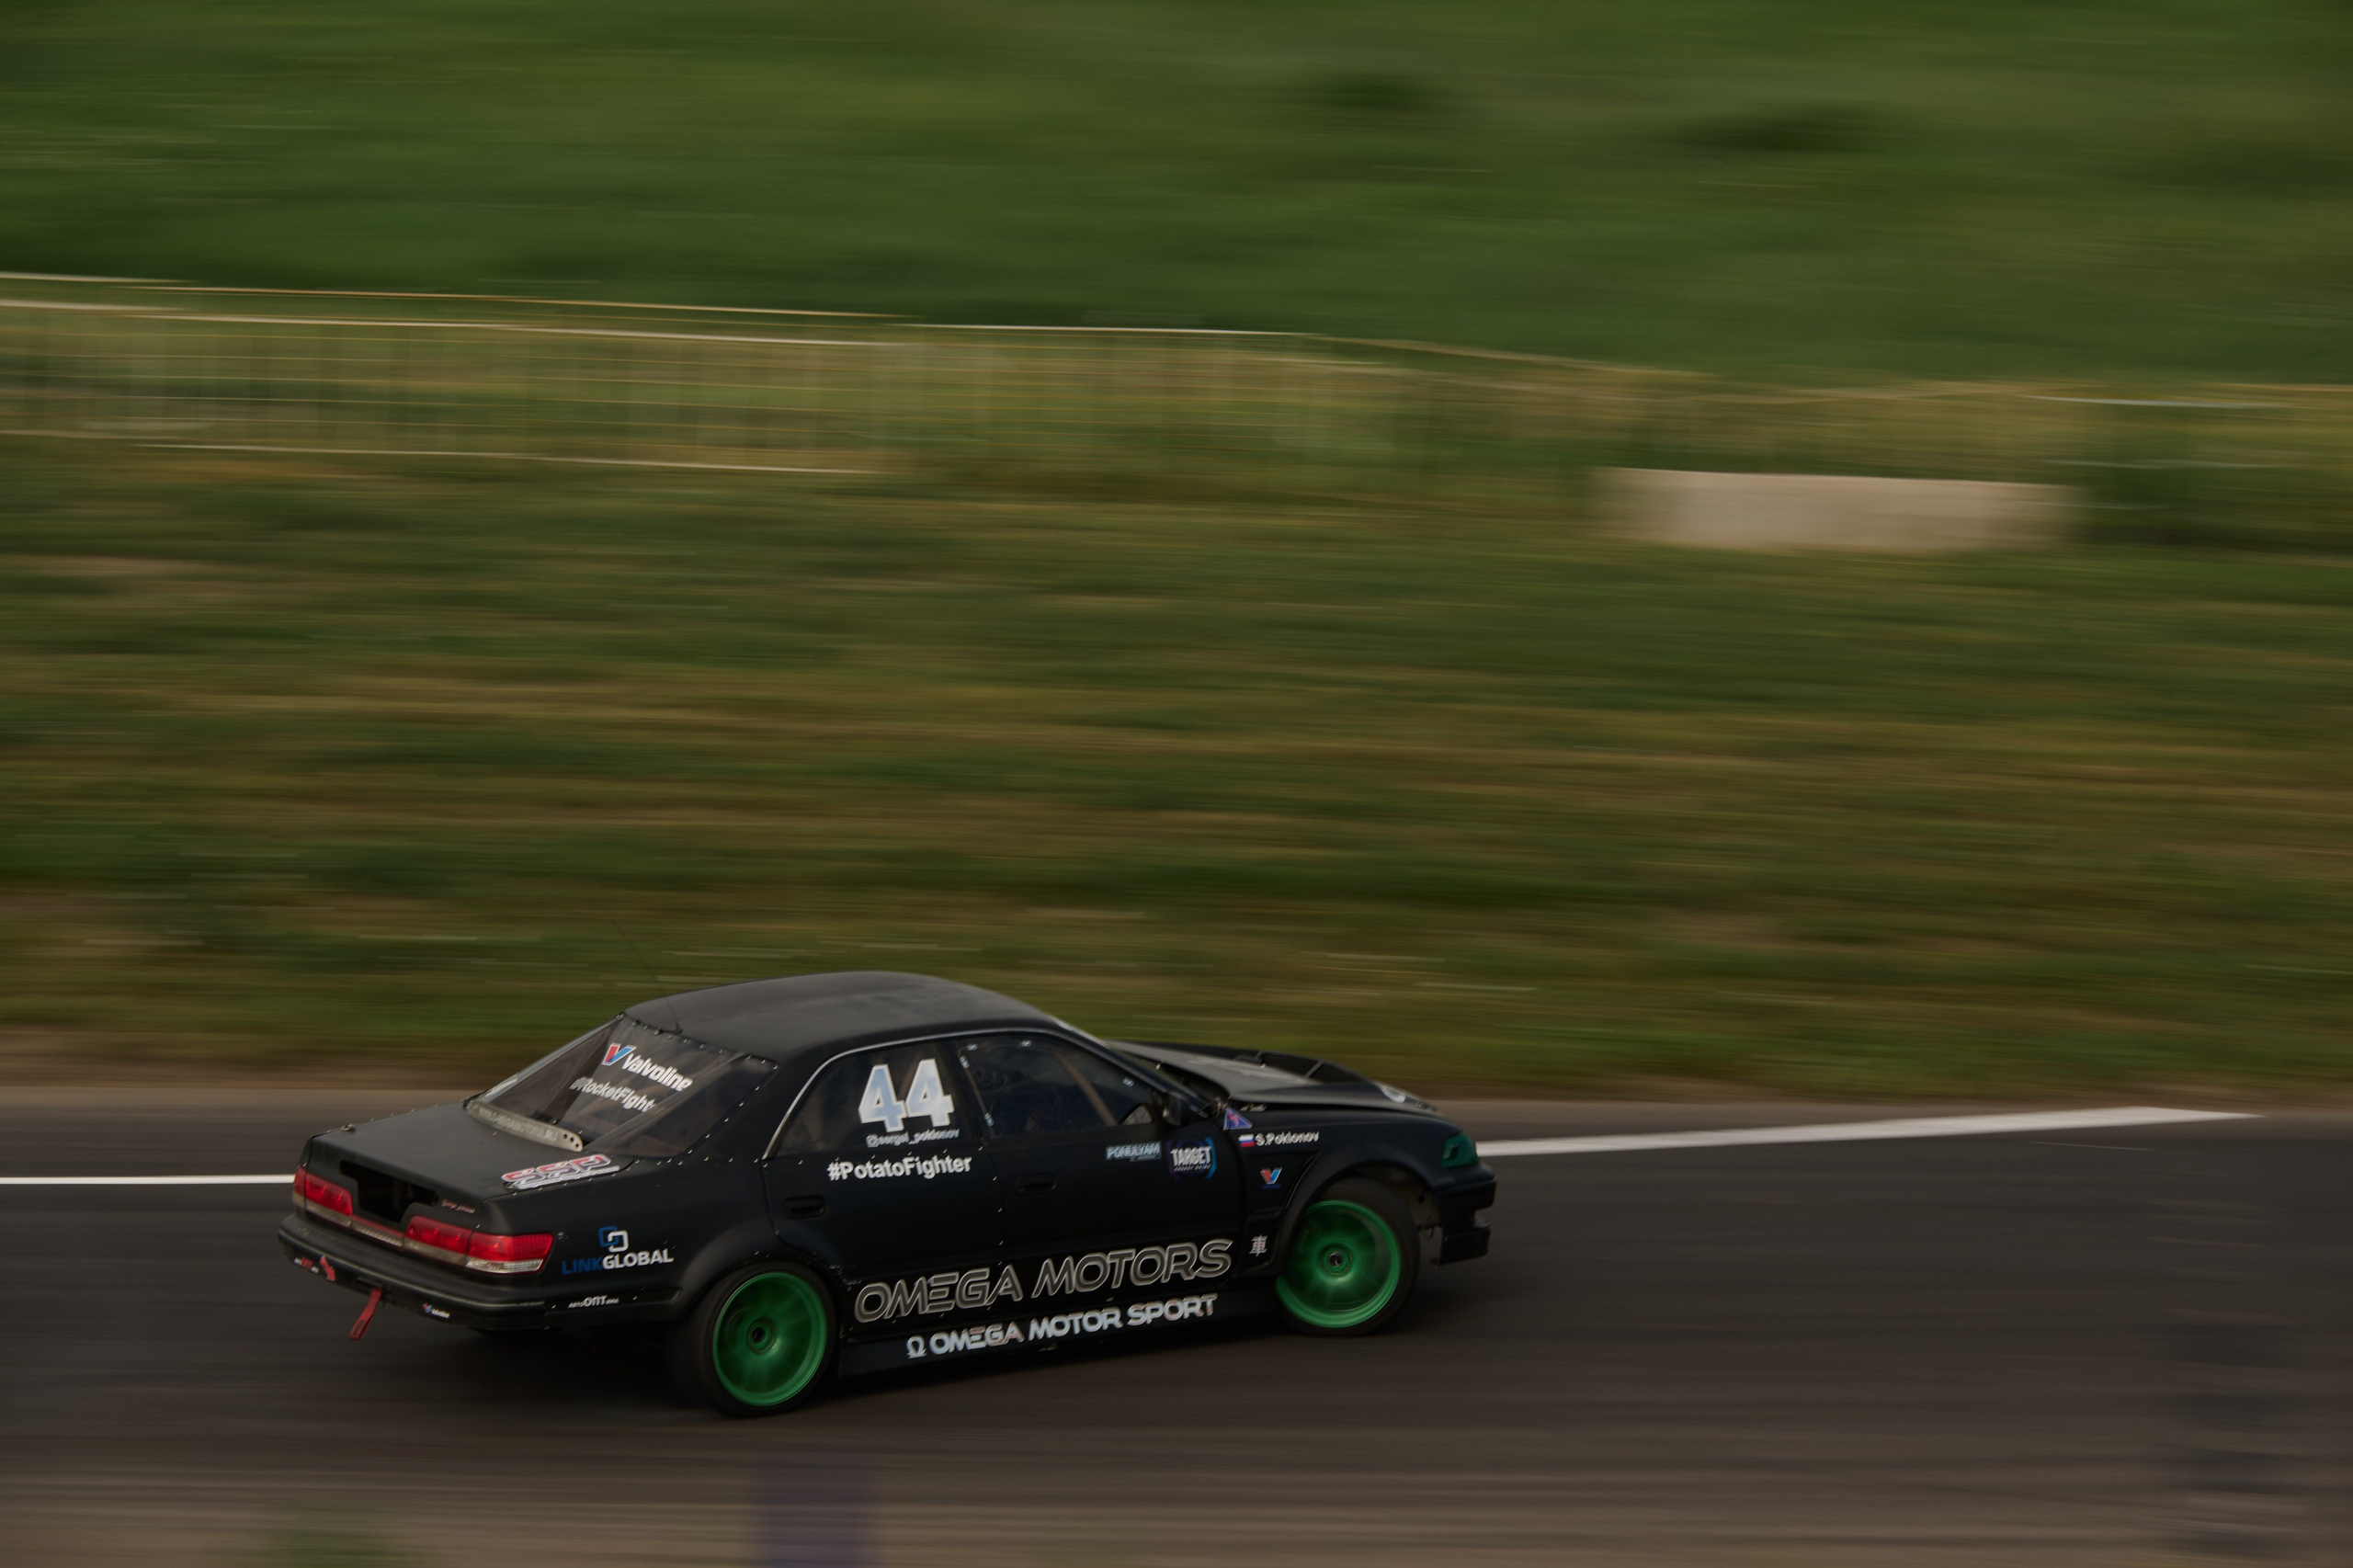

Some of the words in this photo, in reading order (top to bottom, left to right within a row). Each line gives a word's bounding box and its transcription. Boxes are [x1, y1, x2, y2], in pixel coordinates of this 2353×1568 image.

[621, 1052, 694, 1092] Valvoline
[569, 1075, 657, 1112] #RocketFight
[858, 1058, 955, 1132] 44
[826, 1153, 973, 1182] #PotatoFighter
[1170, 1146, 1212, 1165] TARGET
[854, 1263, 1024, 1323] OMEGA
[1032, 1238, 1234, 1301] MOTORS
[929, 1322, 1025, 1356] OMEGA
[1029, 1308, 1122, 1342] MOTOR
[1127, 1294, 1218, 1326] SPORT
